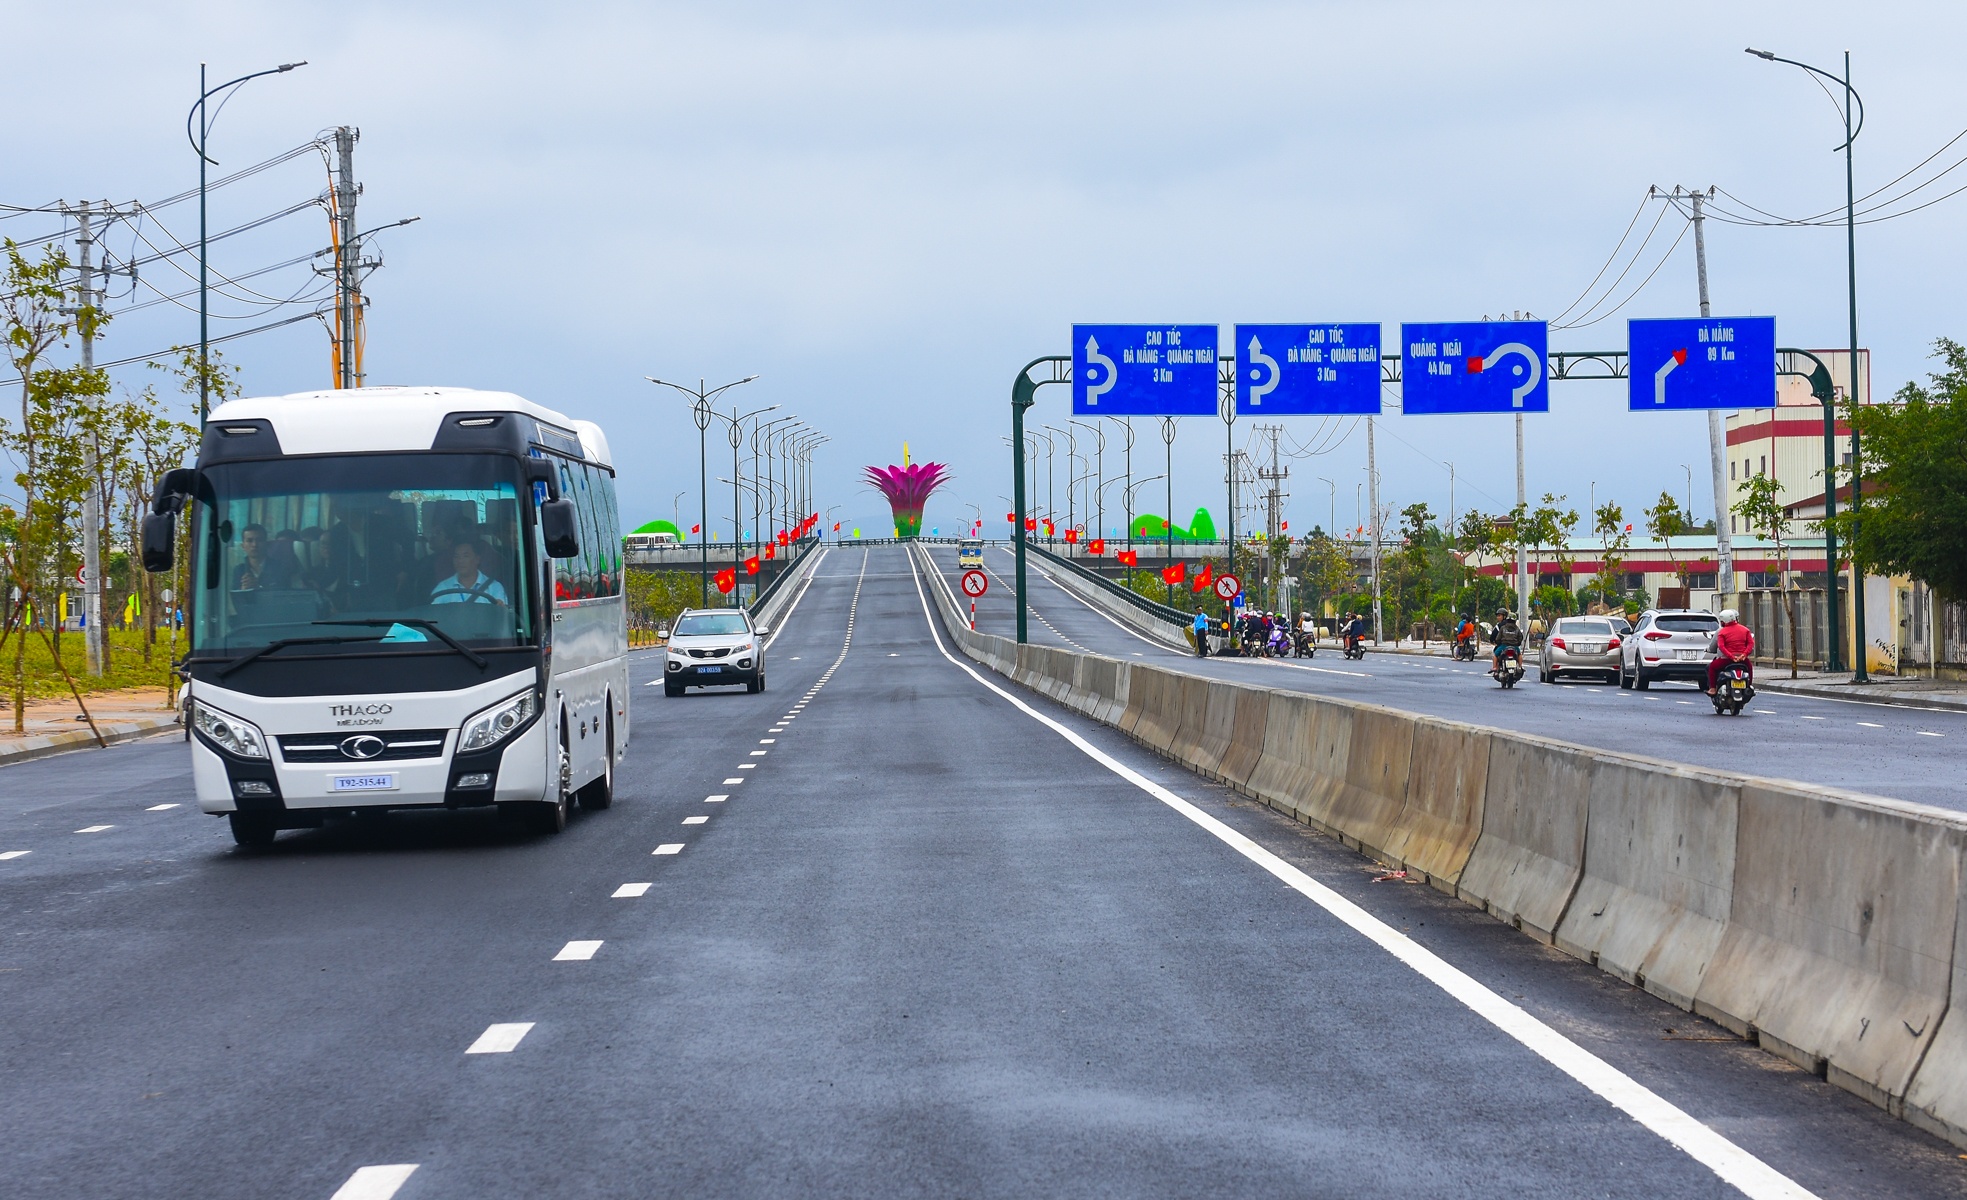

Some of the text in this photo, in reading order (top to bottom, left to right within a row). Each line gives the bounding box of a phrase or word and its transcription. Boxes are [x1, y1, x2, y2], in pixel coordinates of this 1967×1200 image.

[1146, 326, 1181, 345] CAO TỐC
[1309, 324, 1344, 344] CAO TỐC
[1698, 325, 1709, 343] ĐÀ
[1123, 346, 1134, 364] ĐÀ
[1167, 346, 1194, 365] QUẢNG
[1195, 346, 1214, 364] NGÃI
[1287, 345, 1299, 363] ĐÀ
[1330, 344, 1356, 365] QUẢNG
[1358, 345, 1377, 362] NGÃI
[1410, 337, 1437, 359] QUẢNG
[1707, 346, 1735, 361] 89 Km
[1153, 368, 1173, 382] 3 Km
[1317, 367, 1336, 382] 3 Km
[1428, 361, 1452, 376] 44 Km
[328, 703, 393, 716] THACO
[336, 718, 384, 727] MEADOW
[339, 778, 386, 787] T92-515.44
